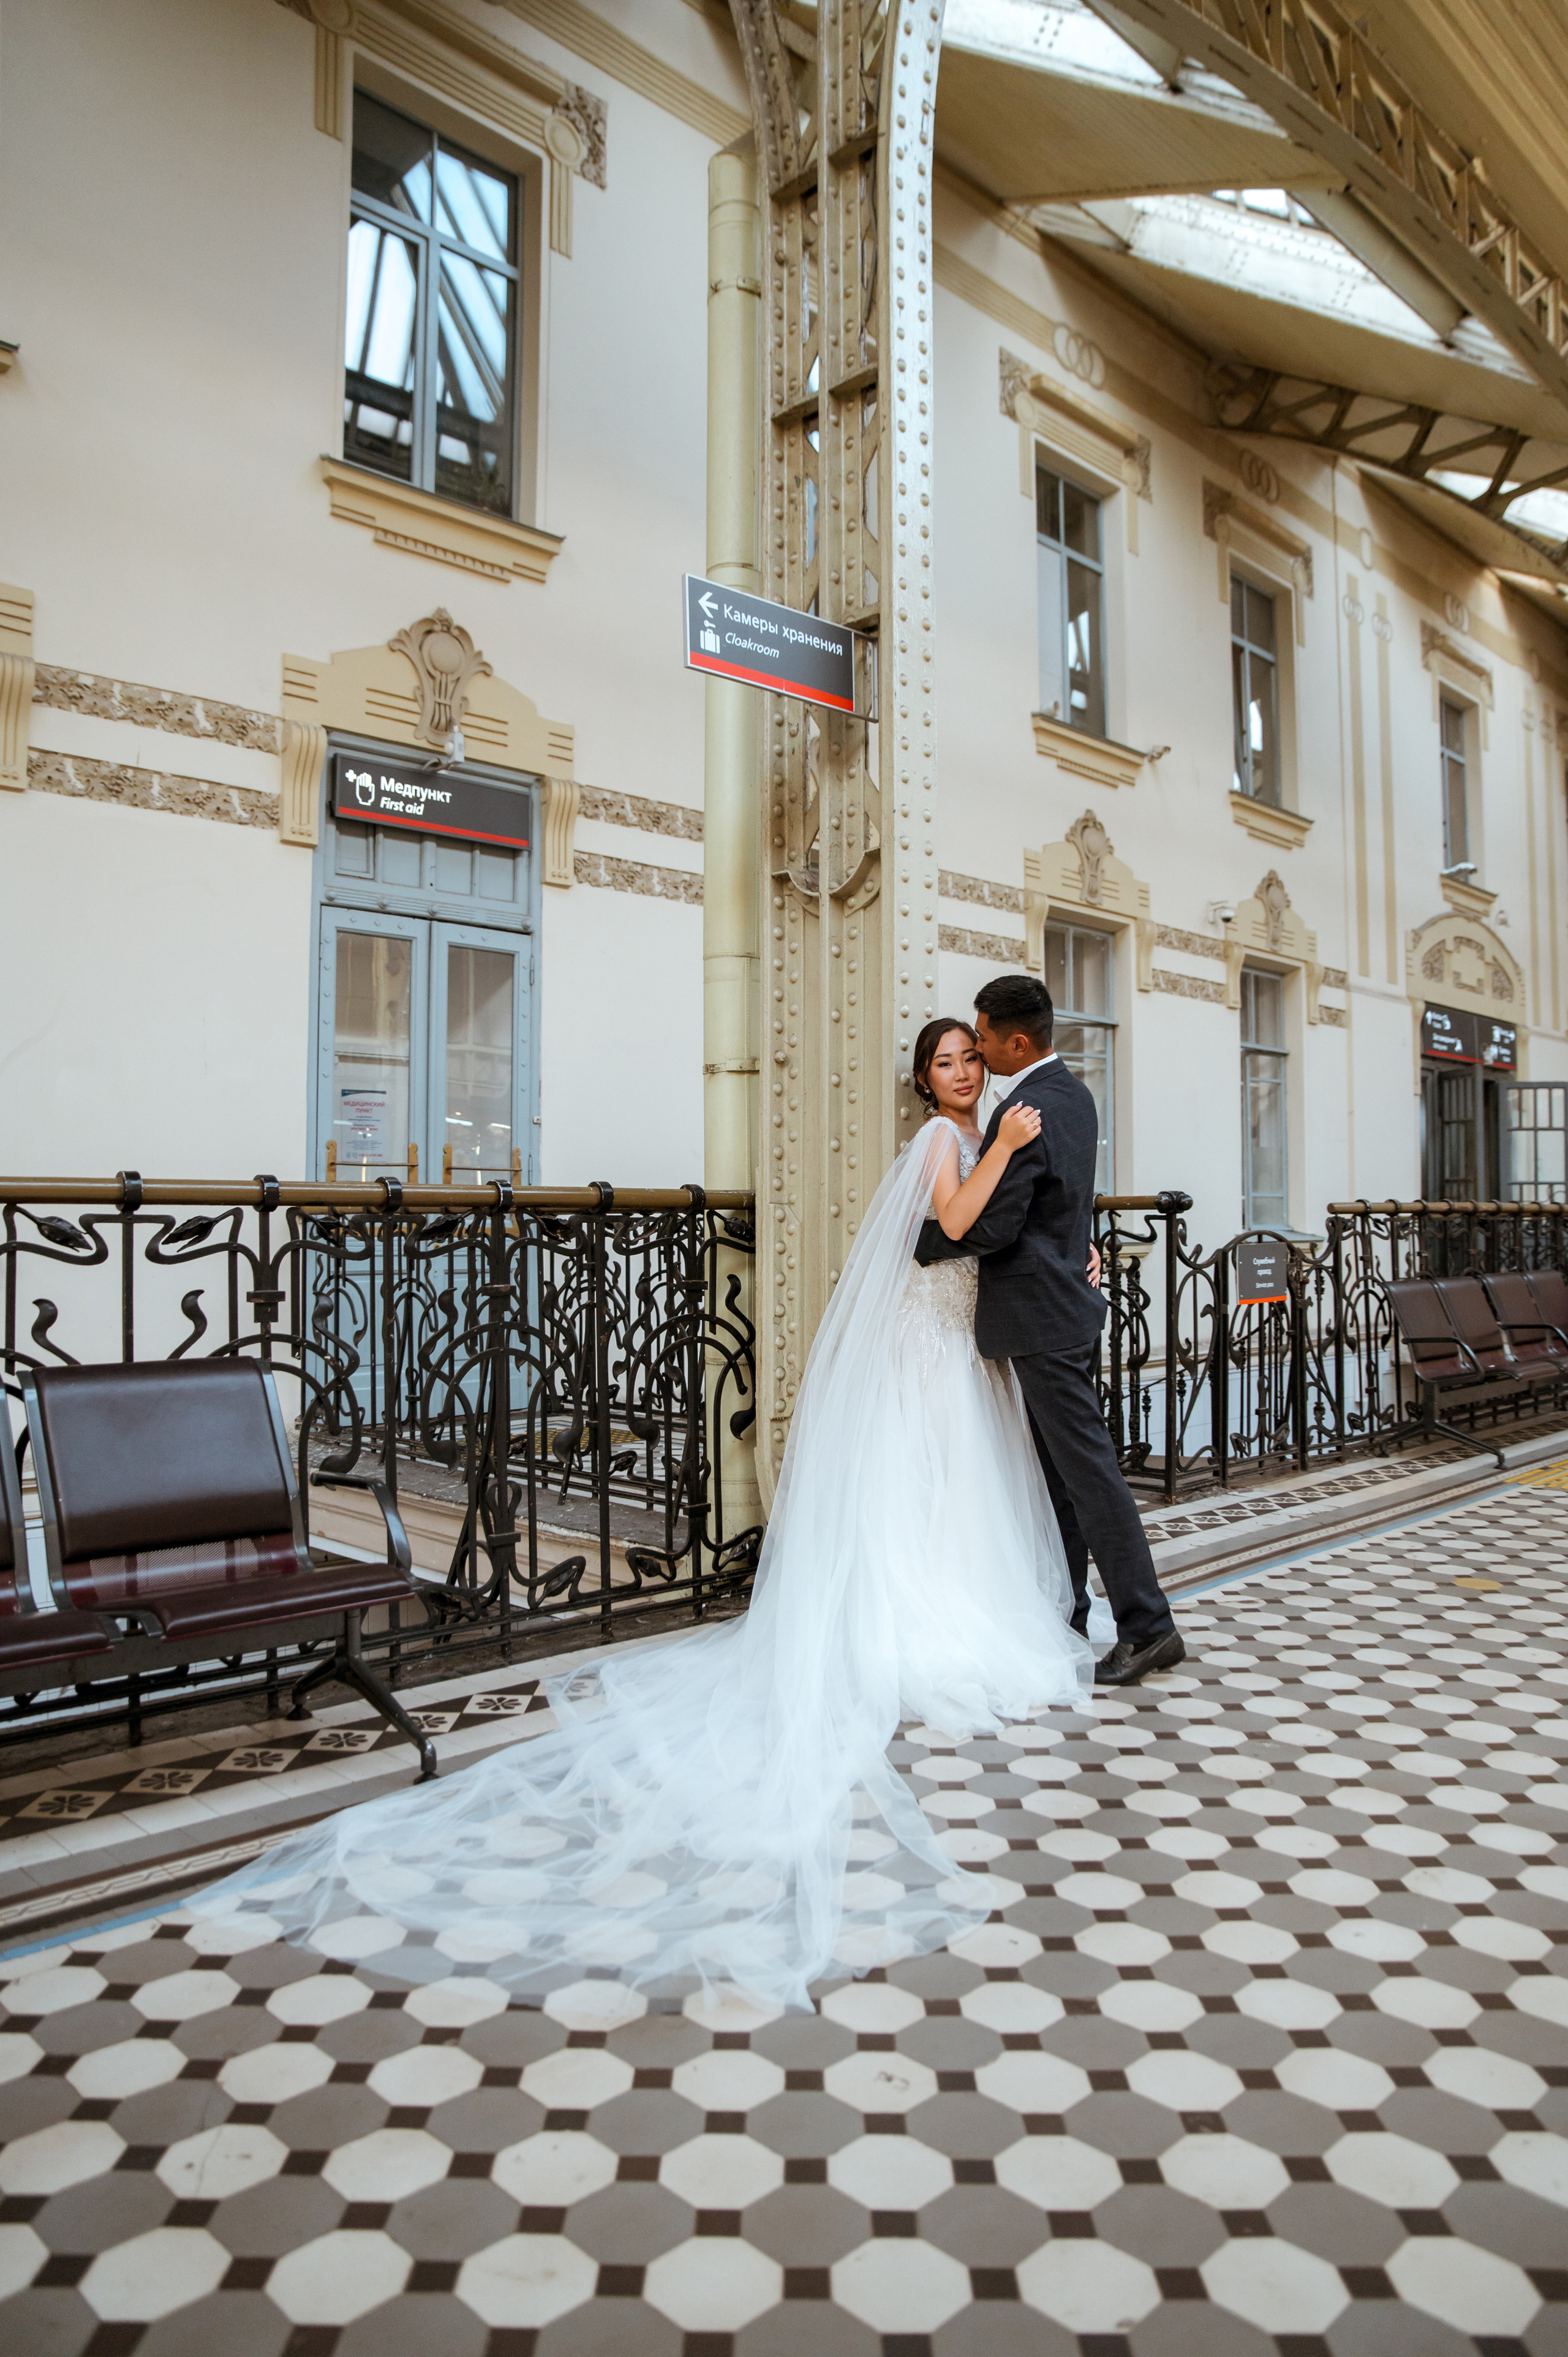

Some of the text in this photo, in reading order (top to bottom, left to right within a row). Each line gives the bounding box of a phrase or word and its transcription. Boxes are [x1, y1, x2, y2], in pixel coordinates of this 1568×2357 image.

[723, 603, 843, 656] Камеры хранения
[725, 632, 780, 659] Cloakroom
[380, 776, 452, 803] Медпункт
[380, 796, 424, 815] First aid
